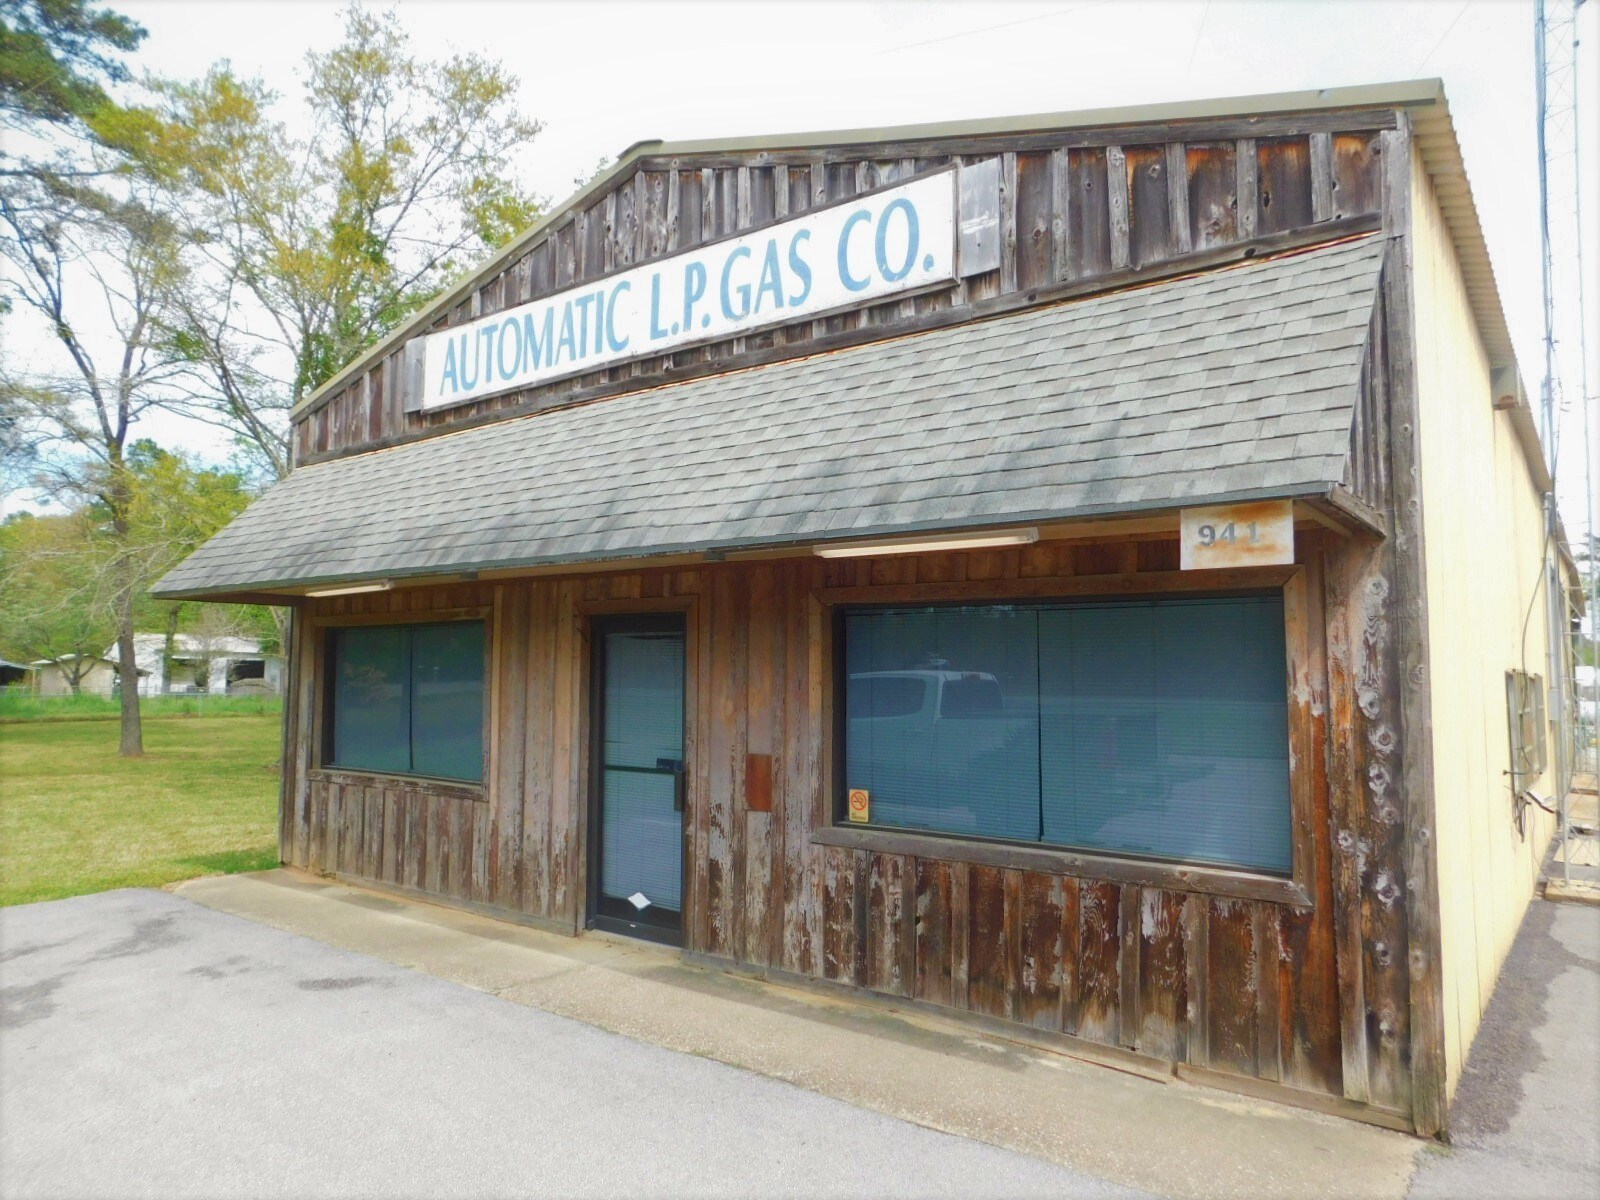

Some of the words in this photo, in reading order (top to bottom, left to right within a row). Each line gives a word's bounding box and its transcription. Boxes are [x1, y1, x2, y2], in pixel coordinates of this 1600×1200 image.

[439, 280, 630, 396] AUTOMATIC
[837, 197, 935, 293] CO.
[1198, 522, 1260, 547] 941
